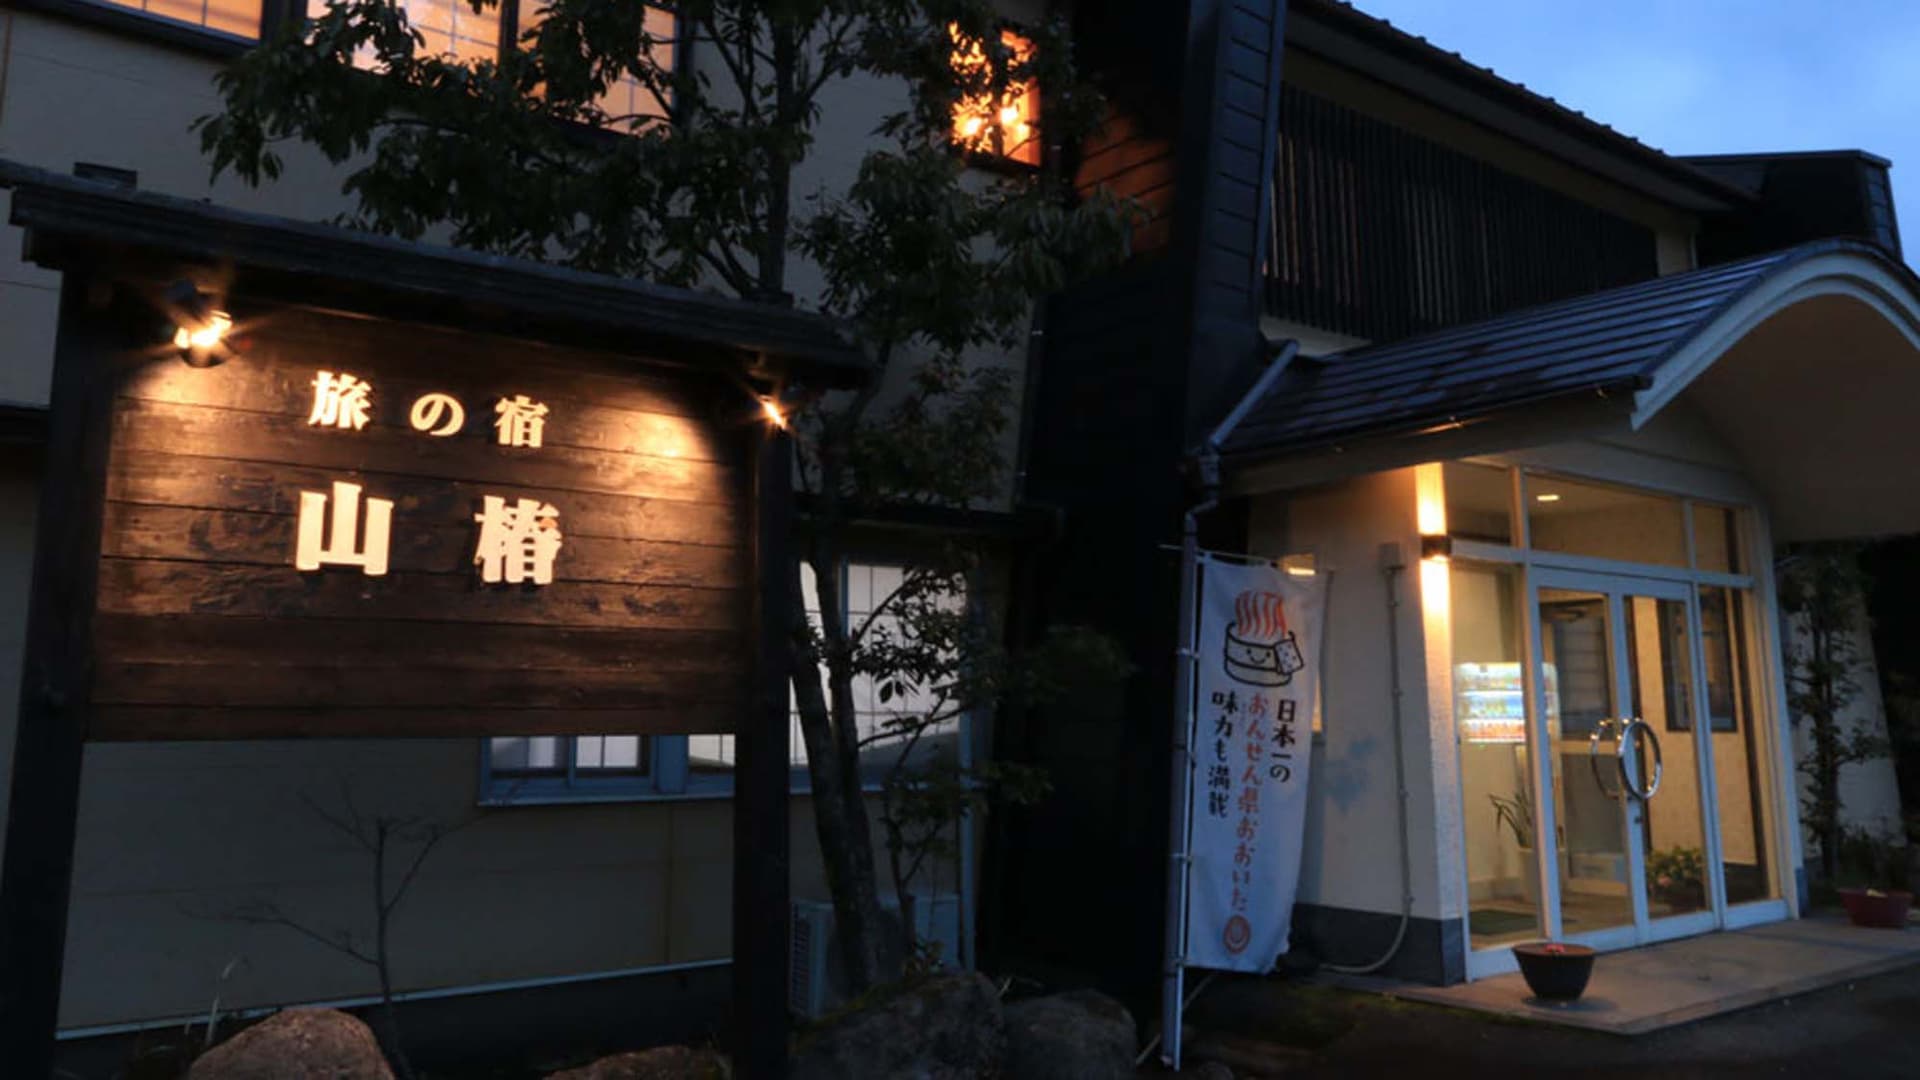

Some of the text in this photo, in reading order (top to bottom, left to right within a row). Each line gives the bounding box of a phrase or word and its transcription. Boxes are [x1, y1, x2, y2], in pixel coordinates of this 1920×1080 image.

[307, 370, 549, 448] 旅の宿
[296, 481, 562, 584] 山椿
[1269, 698, 1296, 783] 日本一の
[1231, 691, 1268, 912] おんせん県おおいた
